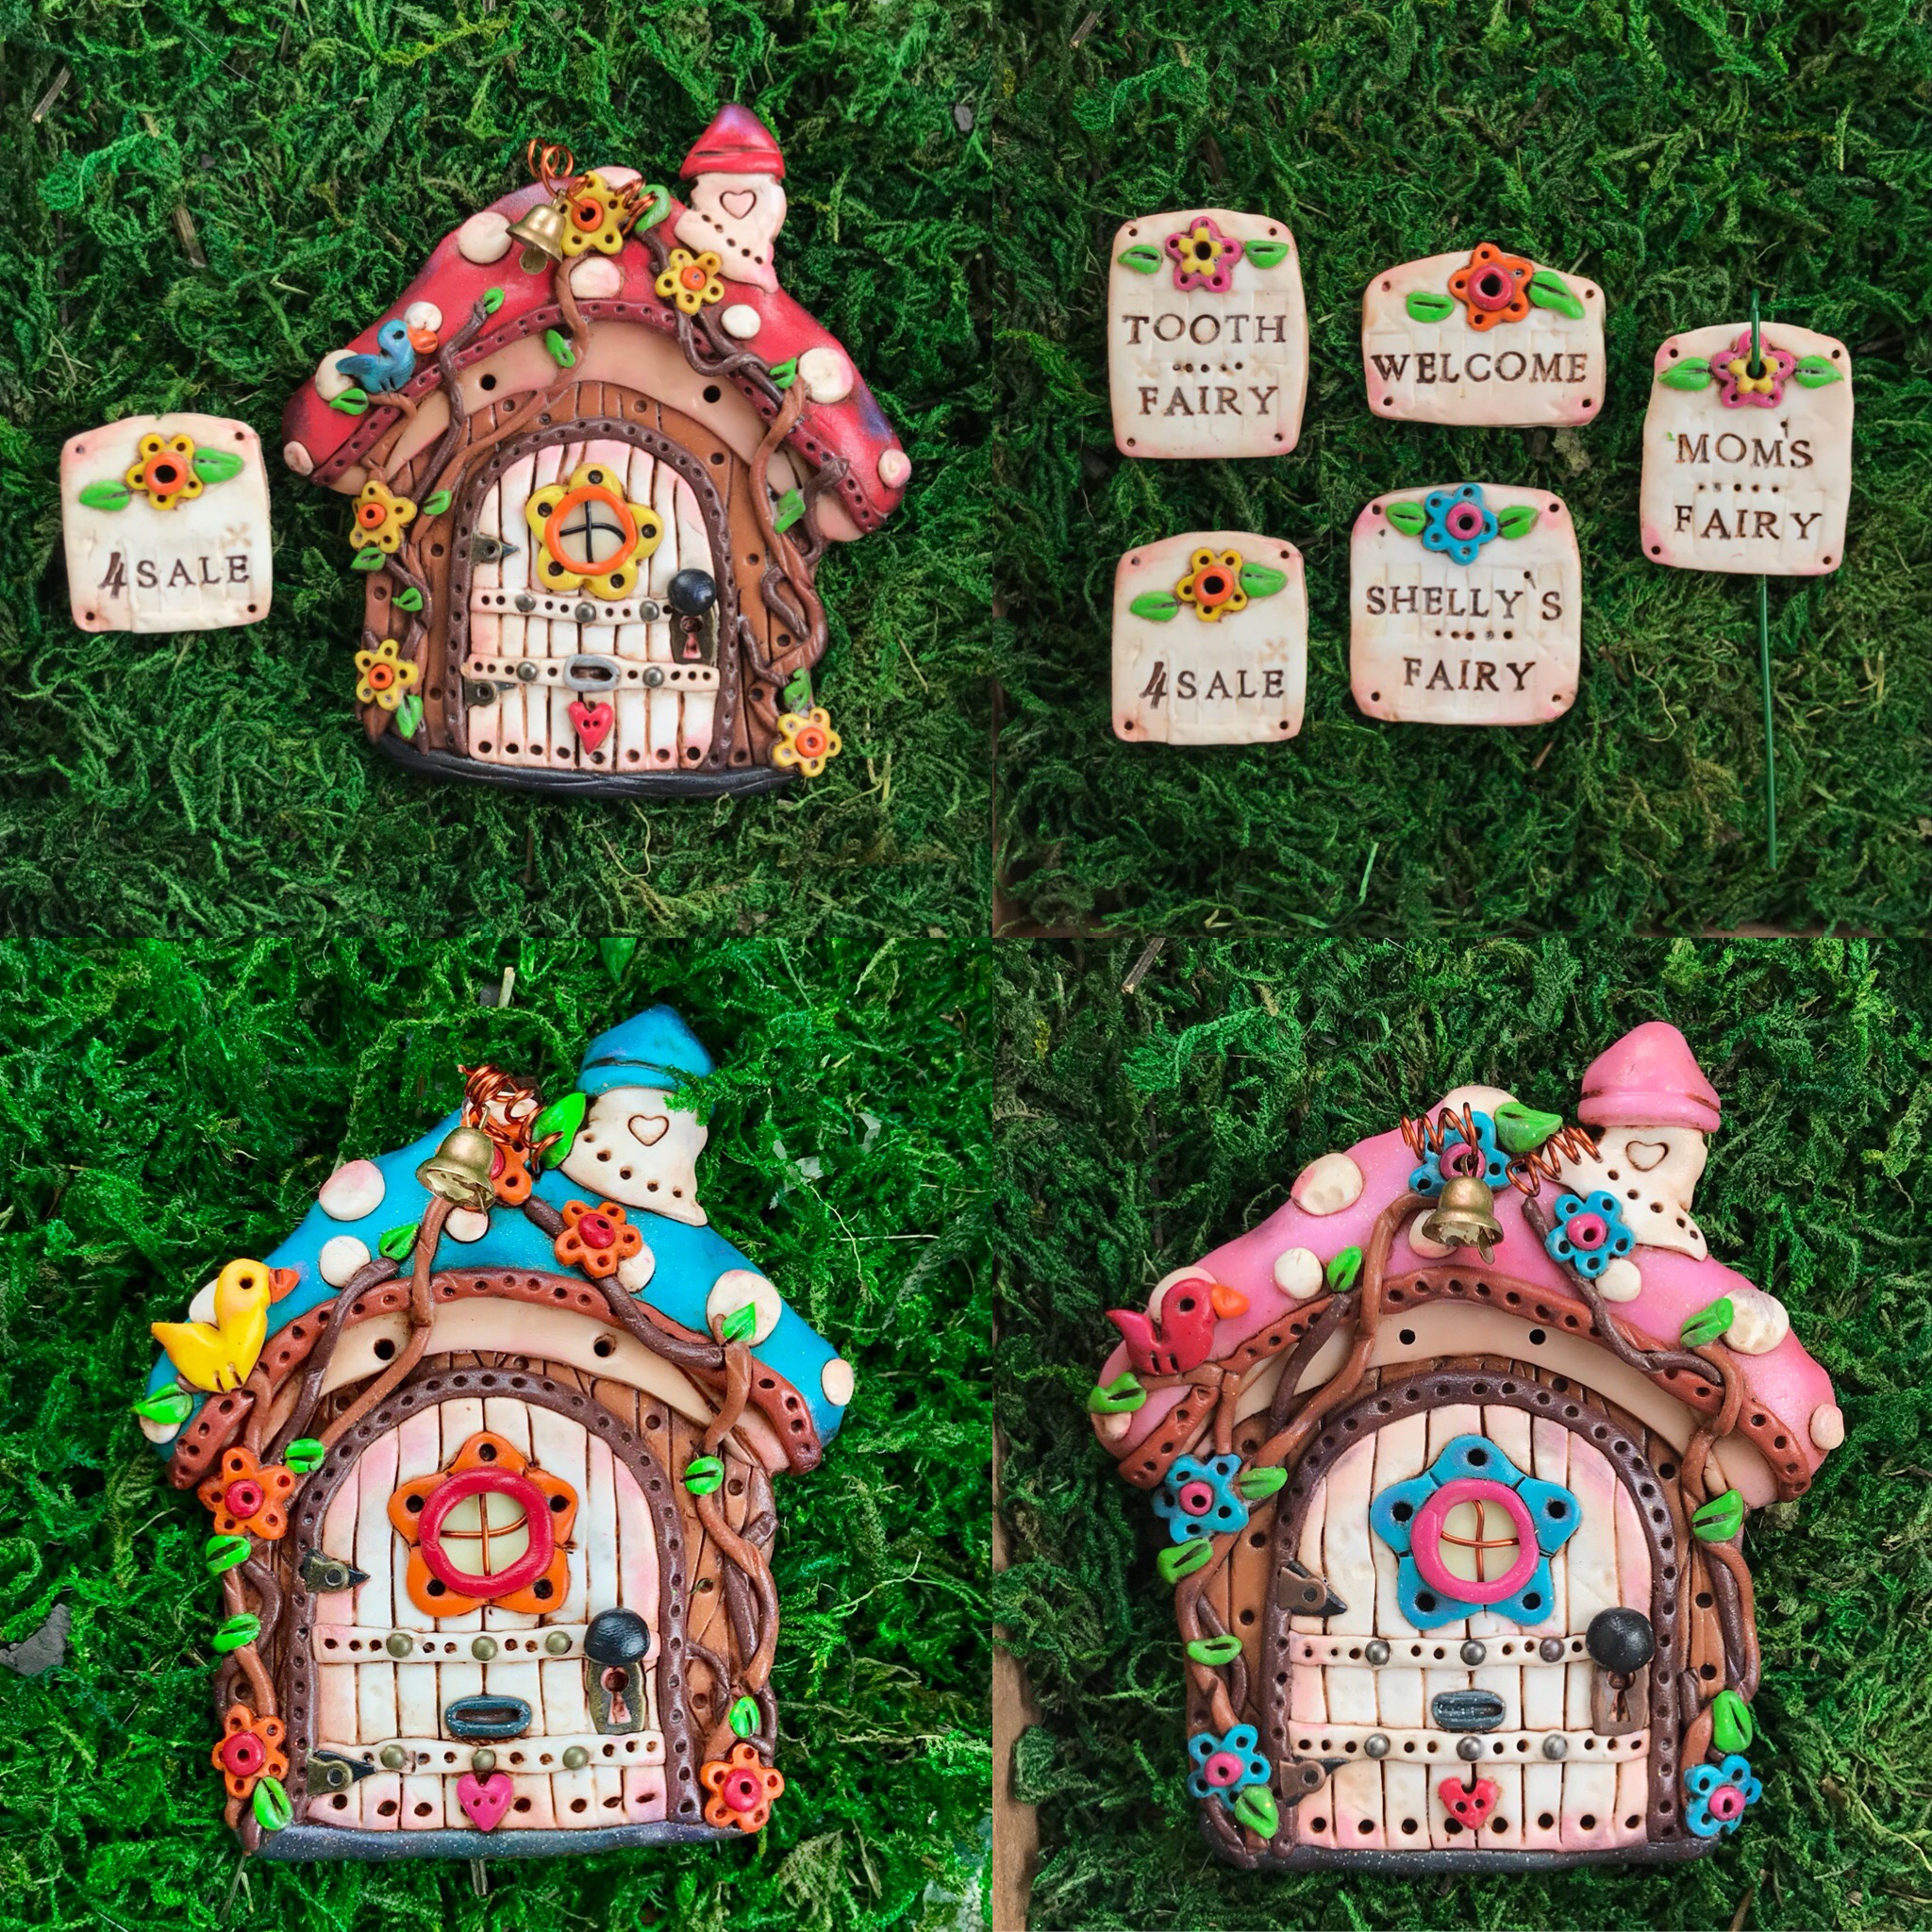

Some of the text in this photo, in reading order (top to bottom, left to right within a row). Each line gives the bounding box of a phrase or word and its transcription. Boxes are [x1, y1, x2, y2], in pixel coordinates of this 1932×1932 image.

[1122, 313, 1287, 345] TOOTH
[1370, 350, 1589, 384] WELCOME
[1139, 385, 1279, 418] FAIRY
[1674, 504, 1823, 541] FAIRY
[1403, 657, 1536, 692] FAIRY
